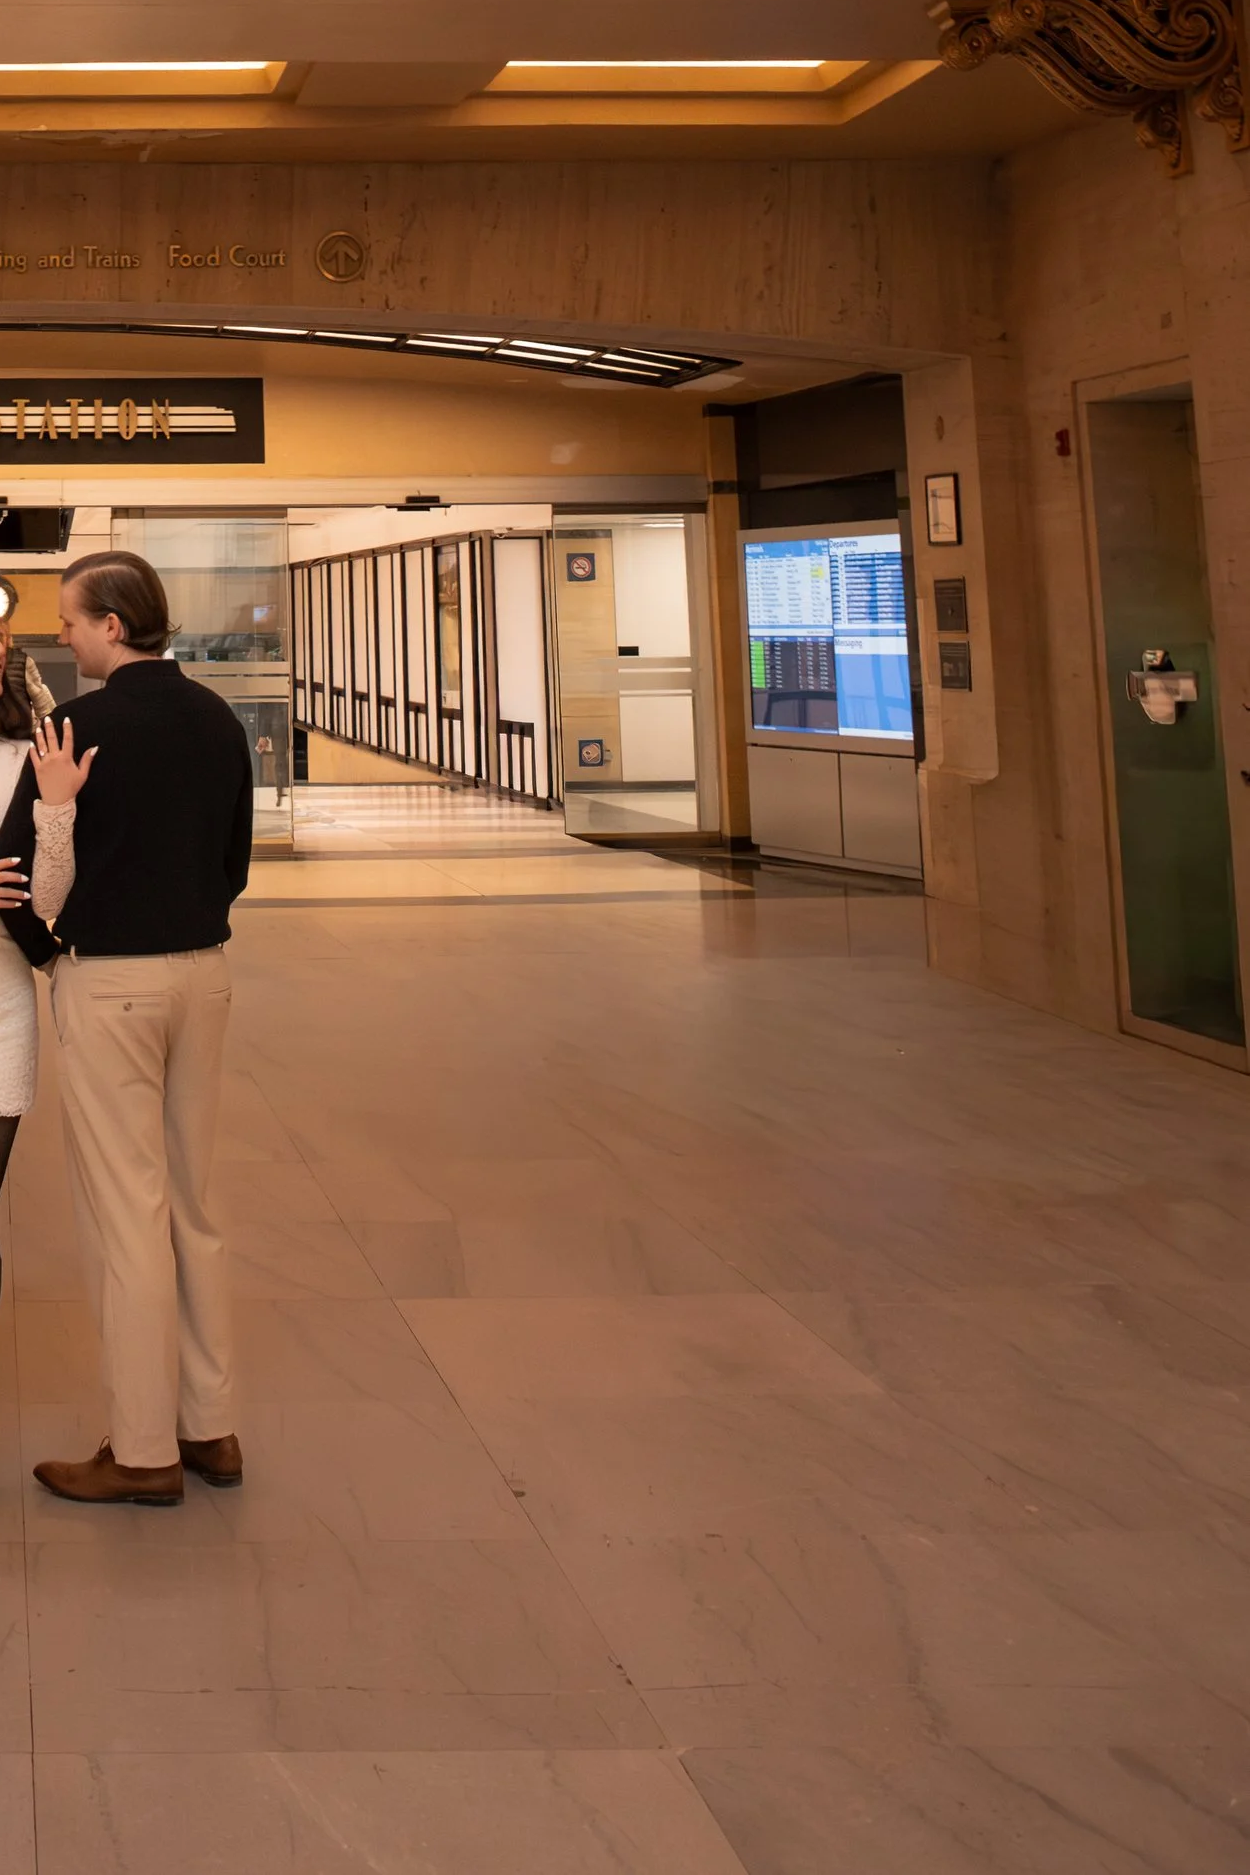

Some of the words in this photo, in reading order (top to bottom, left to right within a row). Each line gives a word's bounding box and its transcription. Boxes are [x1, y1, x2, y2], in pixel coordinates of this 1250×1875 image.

[38, 245, 75, 268] and
[83, 245, 140, 268] Trains
[168, 245, 221, 268] Food
[228, 245, 286, 267] Court
